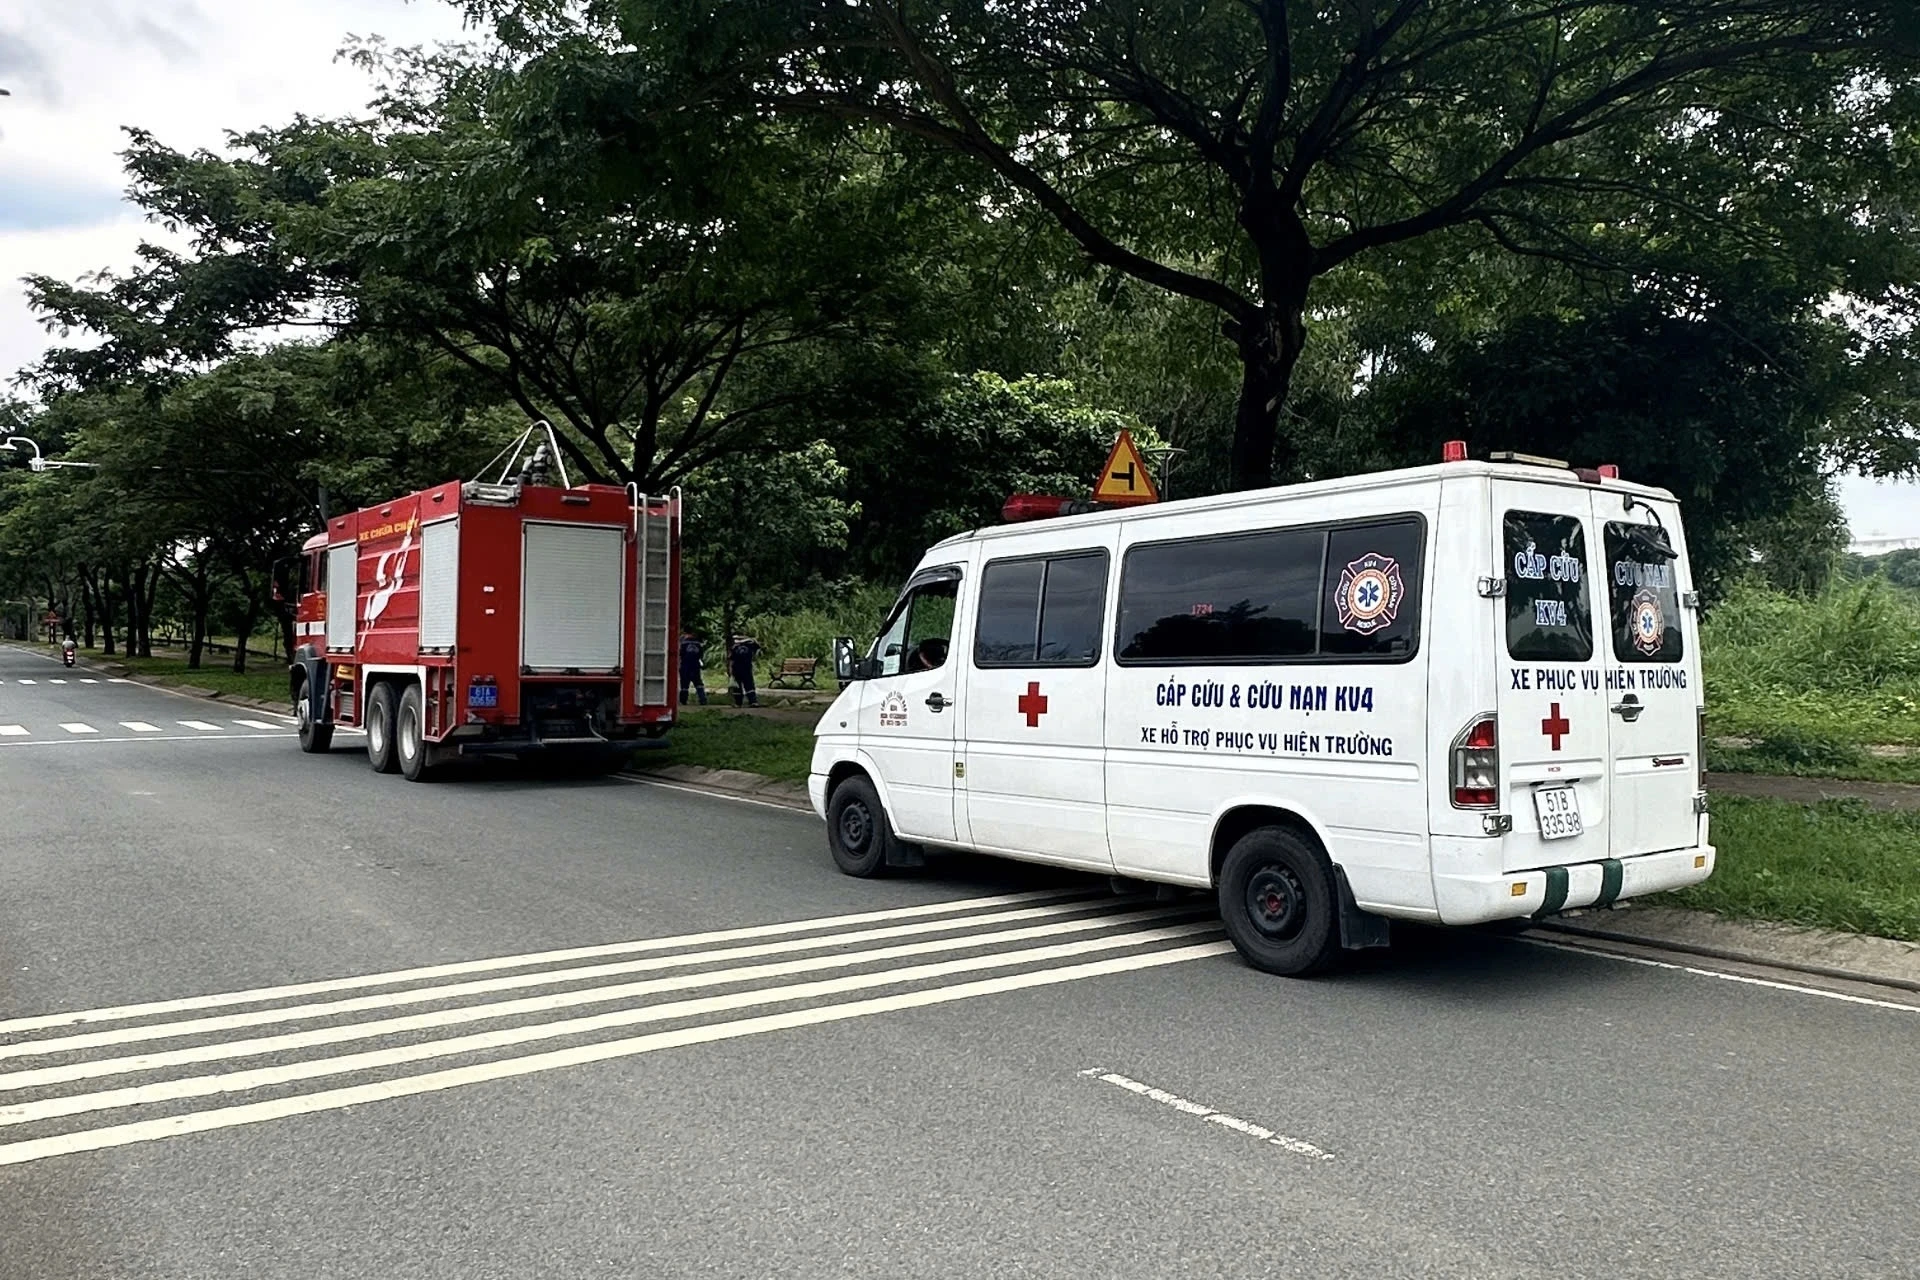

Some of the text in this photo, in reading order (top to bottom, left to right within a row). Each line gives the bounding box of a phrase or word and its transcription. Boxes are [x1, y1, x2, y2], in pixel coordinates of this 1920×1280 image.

[359, 531, 370, 541] XE
[1514, 541, 1579, 583] CẤP CỨU
[1535, 600, 1567, 626] KV4
[1511, 664, 1687, 696] XE PHỤC VỤ HIỆN TRƯỜNG
[1156, 675, 1187, 708] CẤP
[1191, 679, 1225, 708] CỨU
[1229, 684, 1241, 709] &
[1247, 680, 1283, 710] CỨU
[1289, 685, 1328, 716] NẠN
[1141, 720, 1394, 757] XE HỖ TRỢ PHỤC VỤ HIỆN TRƯỜNG
[1545, 790, 1570, 813] 51B
[1542, 811, 1582, 837] 335.98
